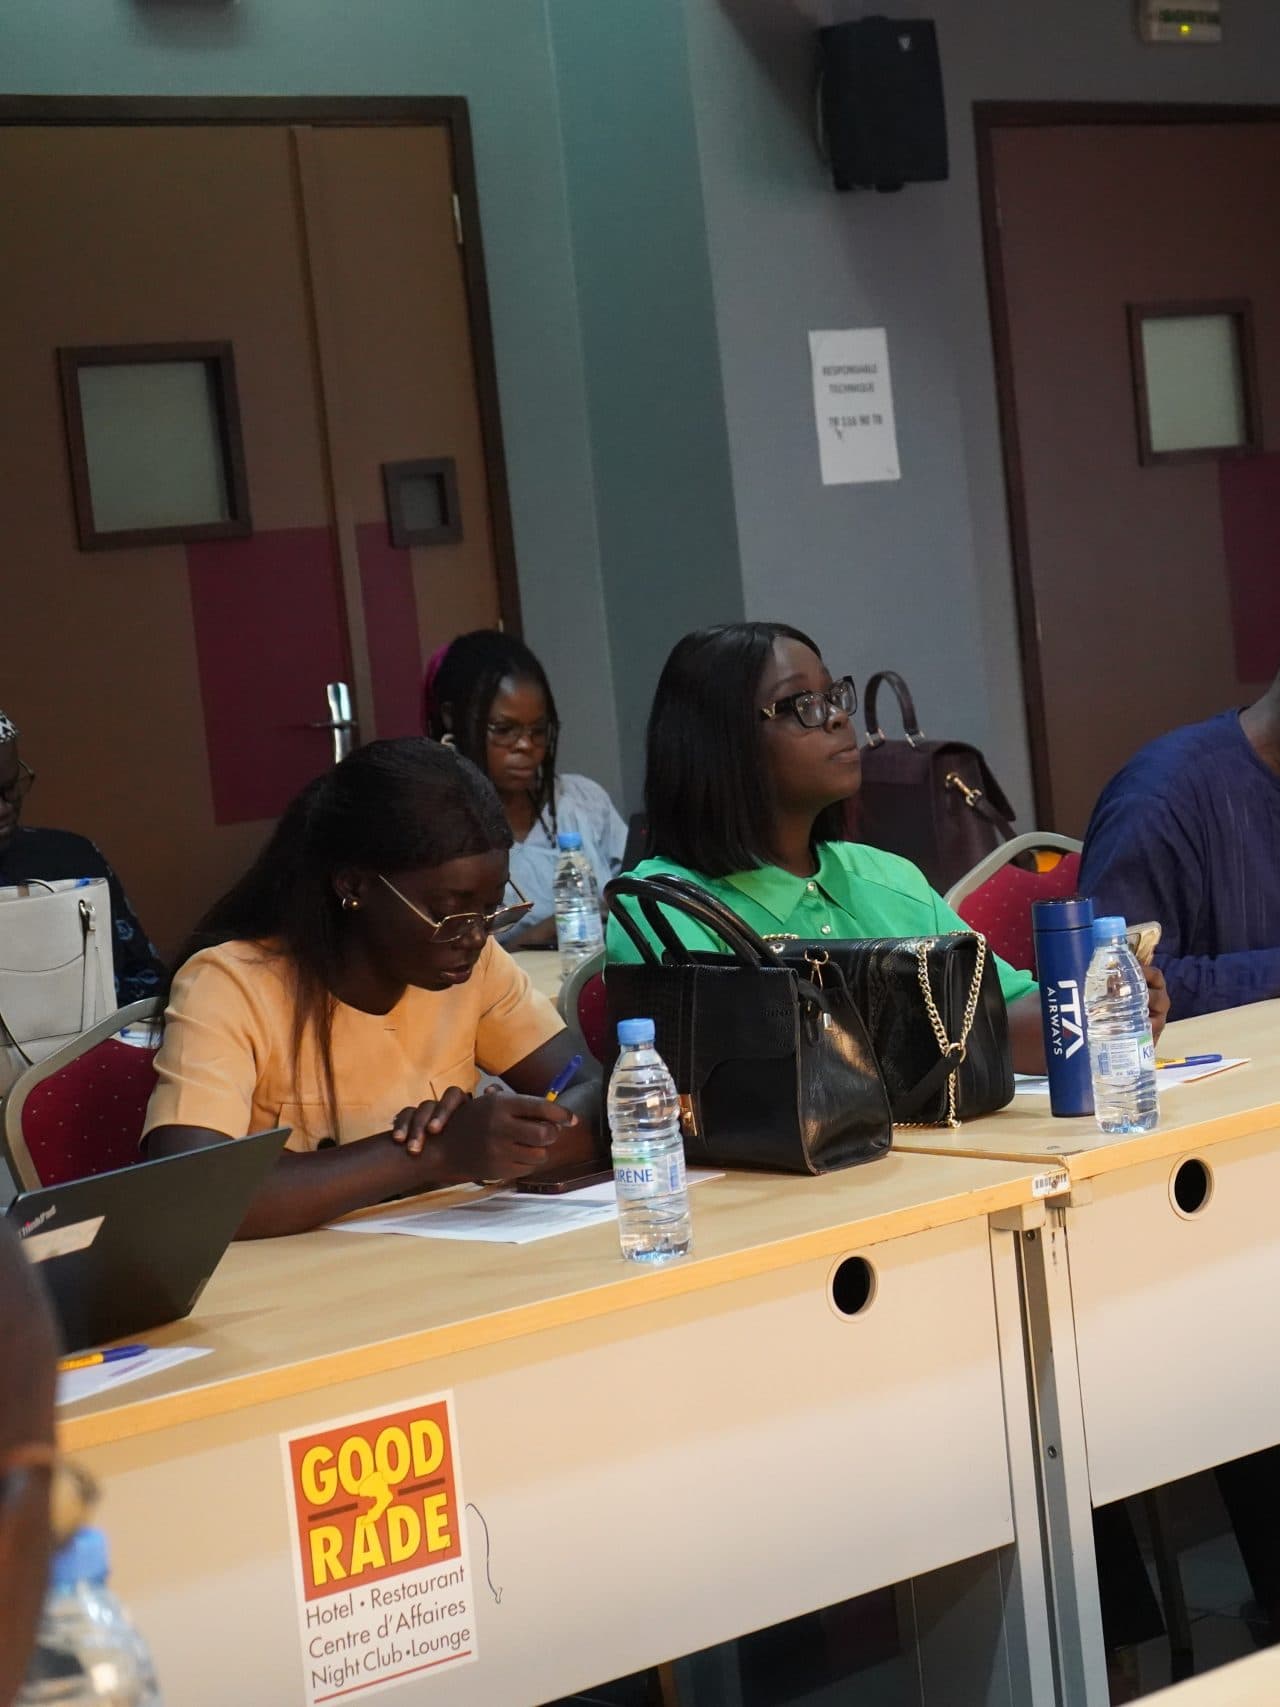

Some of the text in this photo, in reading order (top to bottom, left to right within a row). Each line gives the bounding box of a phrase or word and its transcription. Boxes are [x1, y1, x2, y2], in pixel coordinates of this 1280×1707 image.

[1046, 986, 1064, 1056] AIRWAYS
[1058, 979, 1085, 1060] ITA
[301, 1417, 444, 1506] GOOD
[308, 1492, 451, 1587] RADE
[305, 1565, 465, 1629] Hotel Restaurant
[309, 1628, 370, 1659] Centre
[311, 1657, 361, 1690] Night
[363, 1644, 403, 1673] Club
